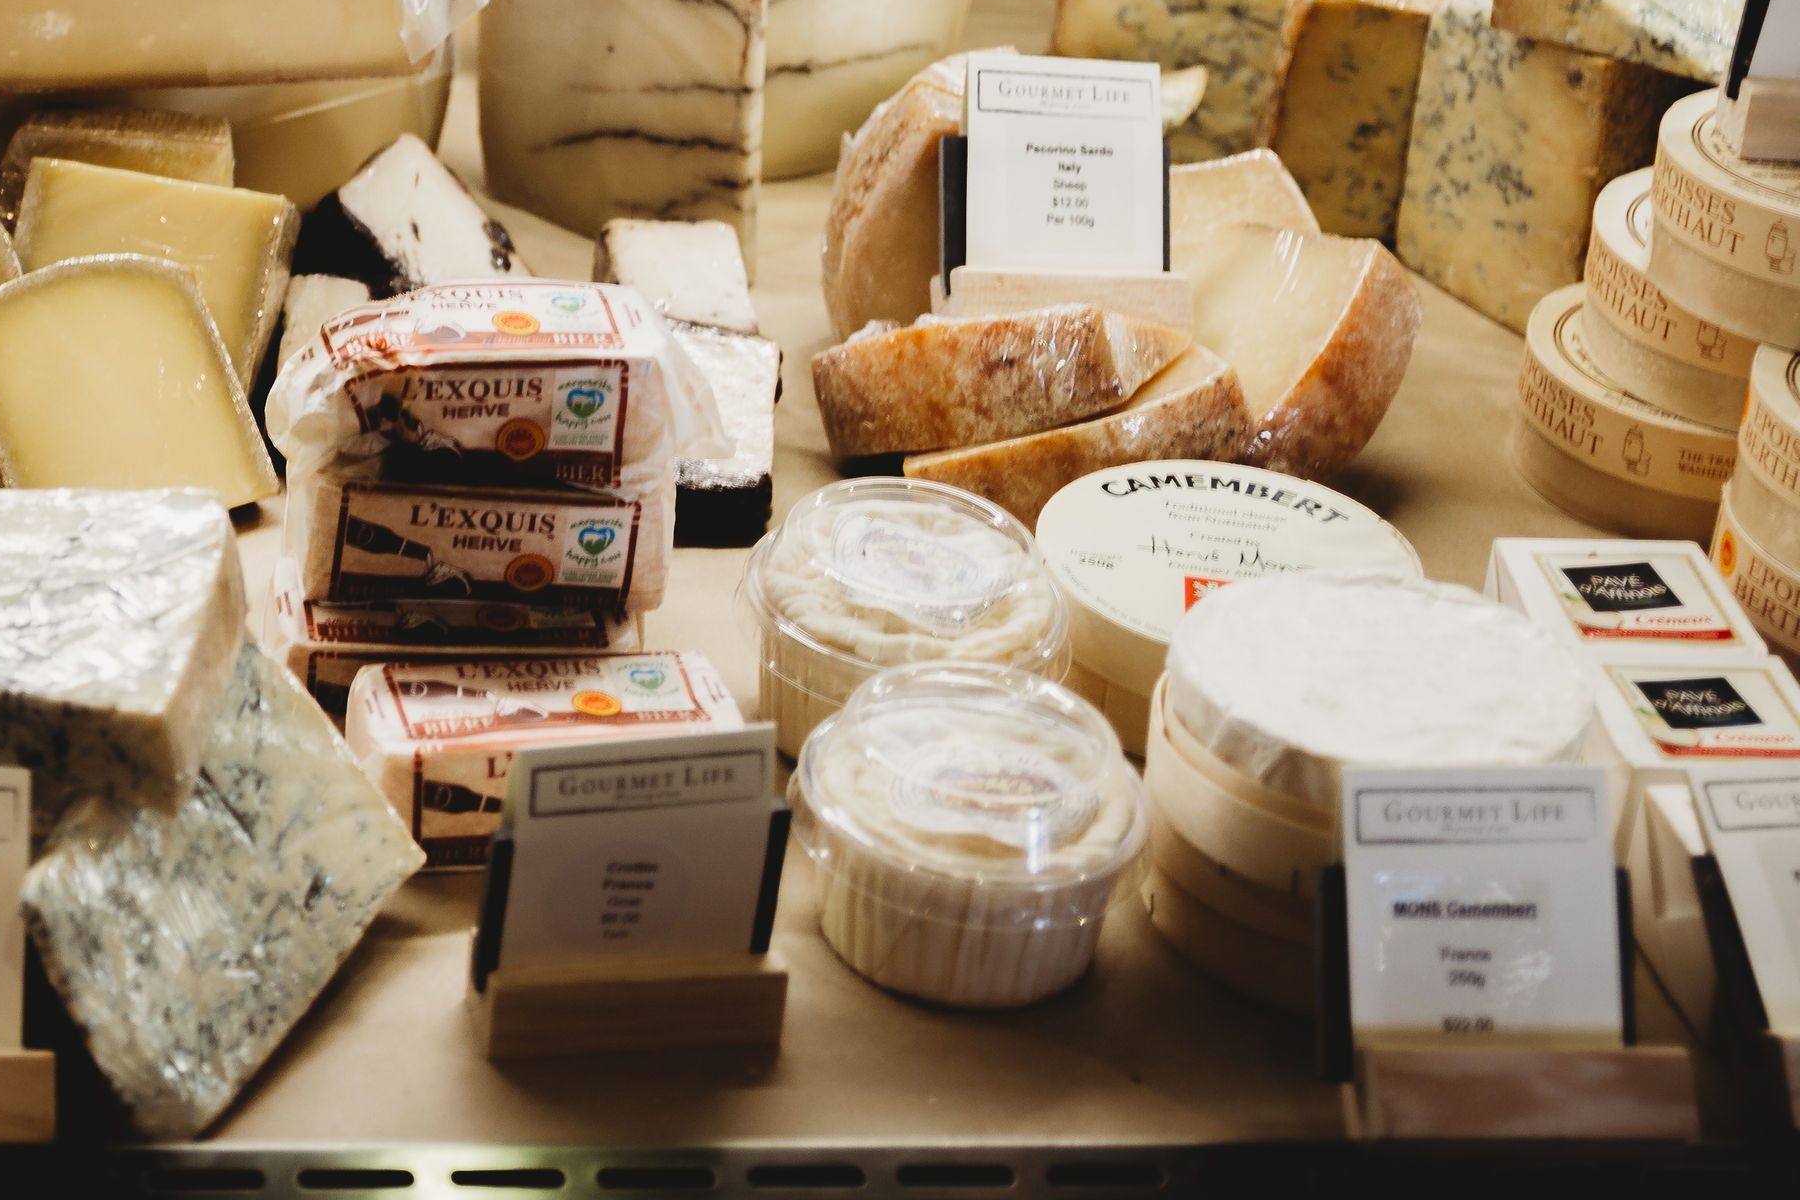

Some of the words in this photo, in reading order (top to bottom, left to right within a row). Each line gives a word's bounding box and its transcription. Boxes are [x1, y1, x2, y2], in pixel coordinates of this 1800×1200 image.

[1058, 162, 1082, 175] Italy
[431, 302, 497, 310] HERVE
[442, 403, 510, 419] HERVE
[1101, 473, 1350, 525] CAMEMBERT
[410, 503, 556, 541] L'EXQUIS
[453, 535, 522, 553] HERVE
[507, 678, 575, 692] HERVE
